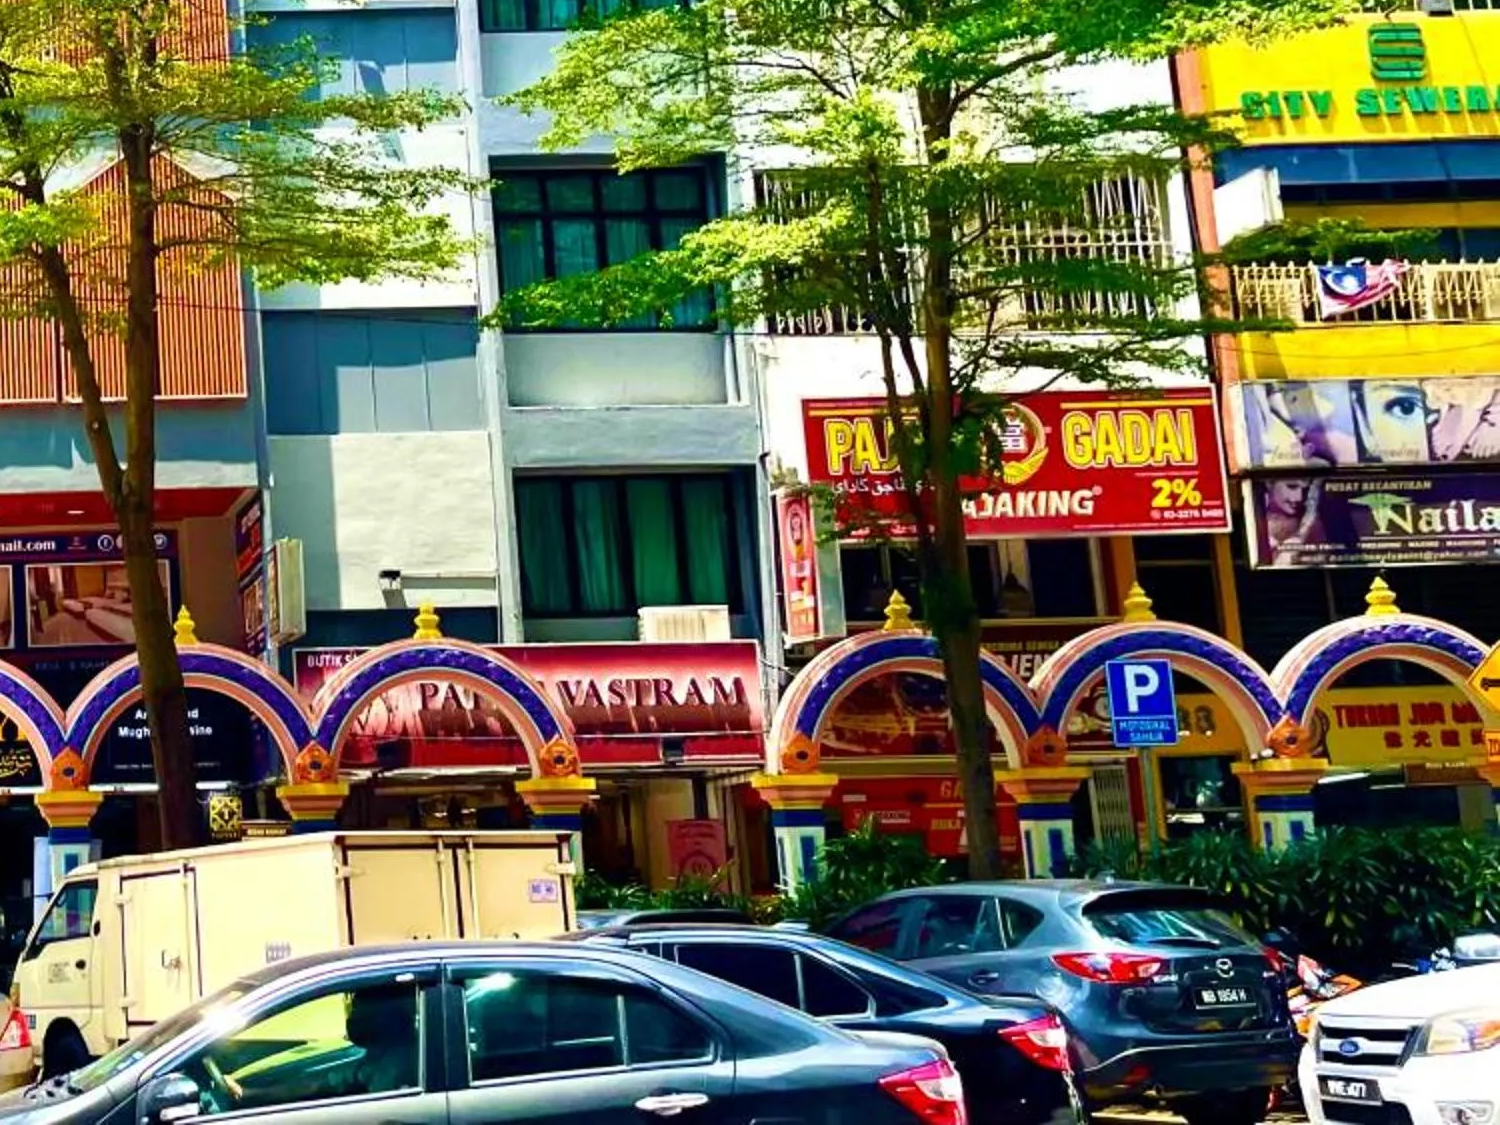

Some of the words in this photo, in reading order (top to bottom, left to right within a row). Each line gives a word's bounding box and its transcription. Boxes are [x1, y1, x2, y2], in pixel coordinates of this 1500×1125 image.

[1355, 85, 1500, 117] SEWER
[1061, 409, 1198, 469] GADAI
[1151, 478, 1203, 508] 2%
[307, 654, 343, 668] BUTIK
[1123, 664, 1159, 713] P
